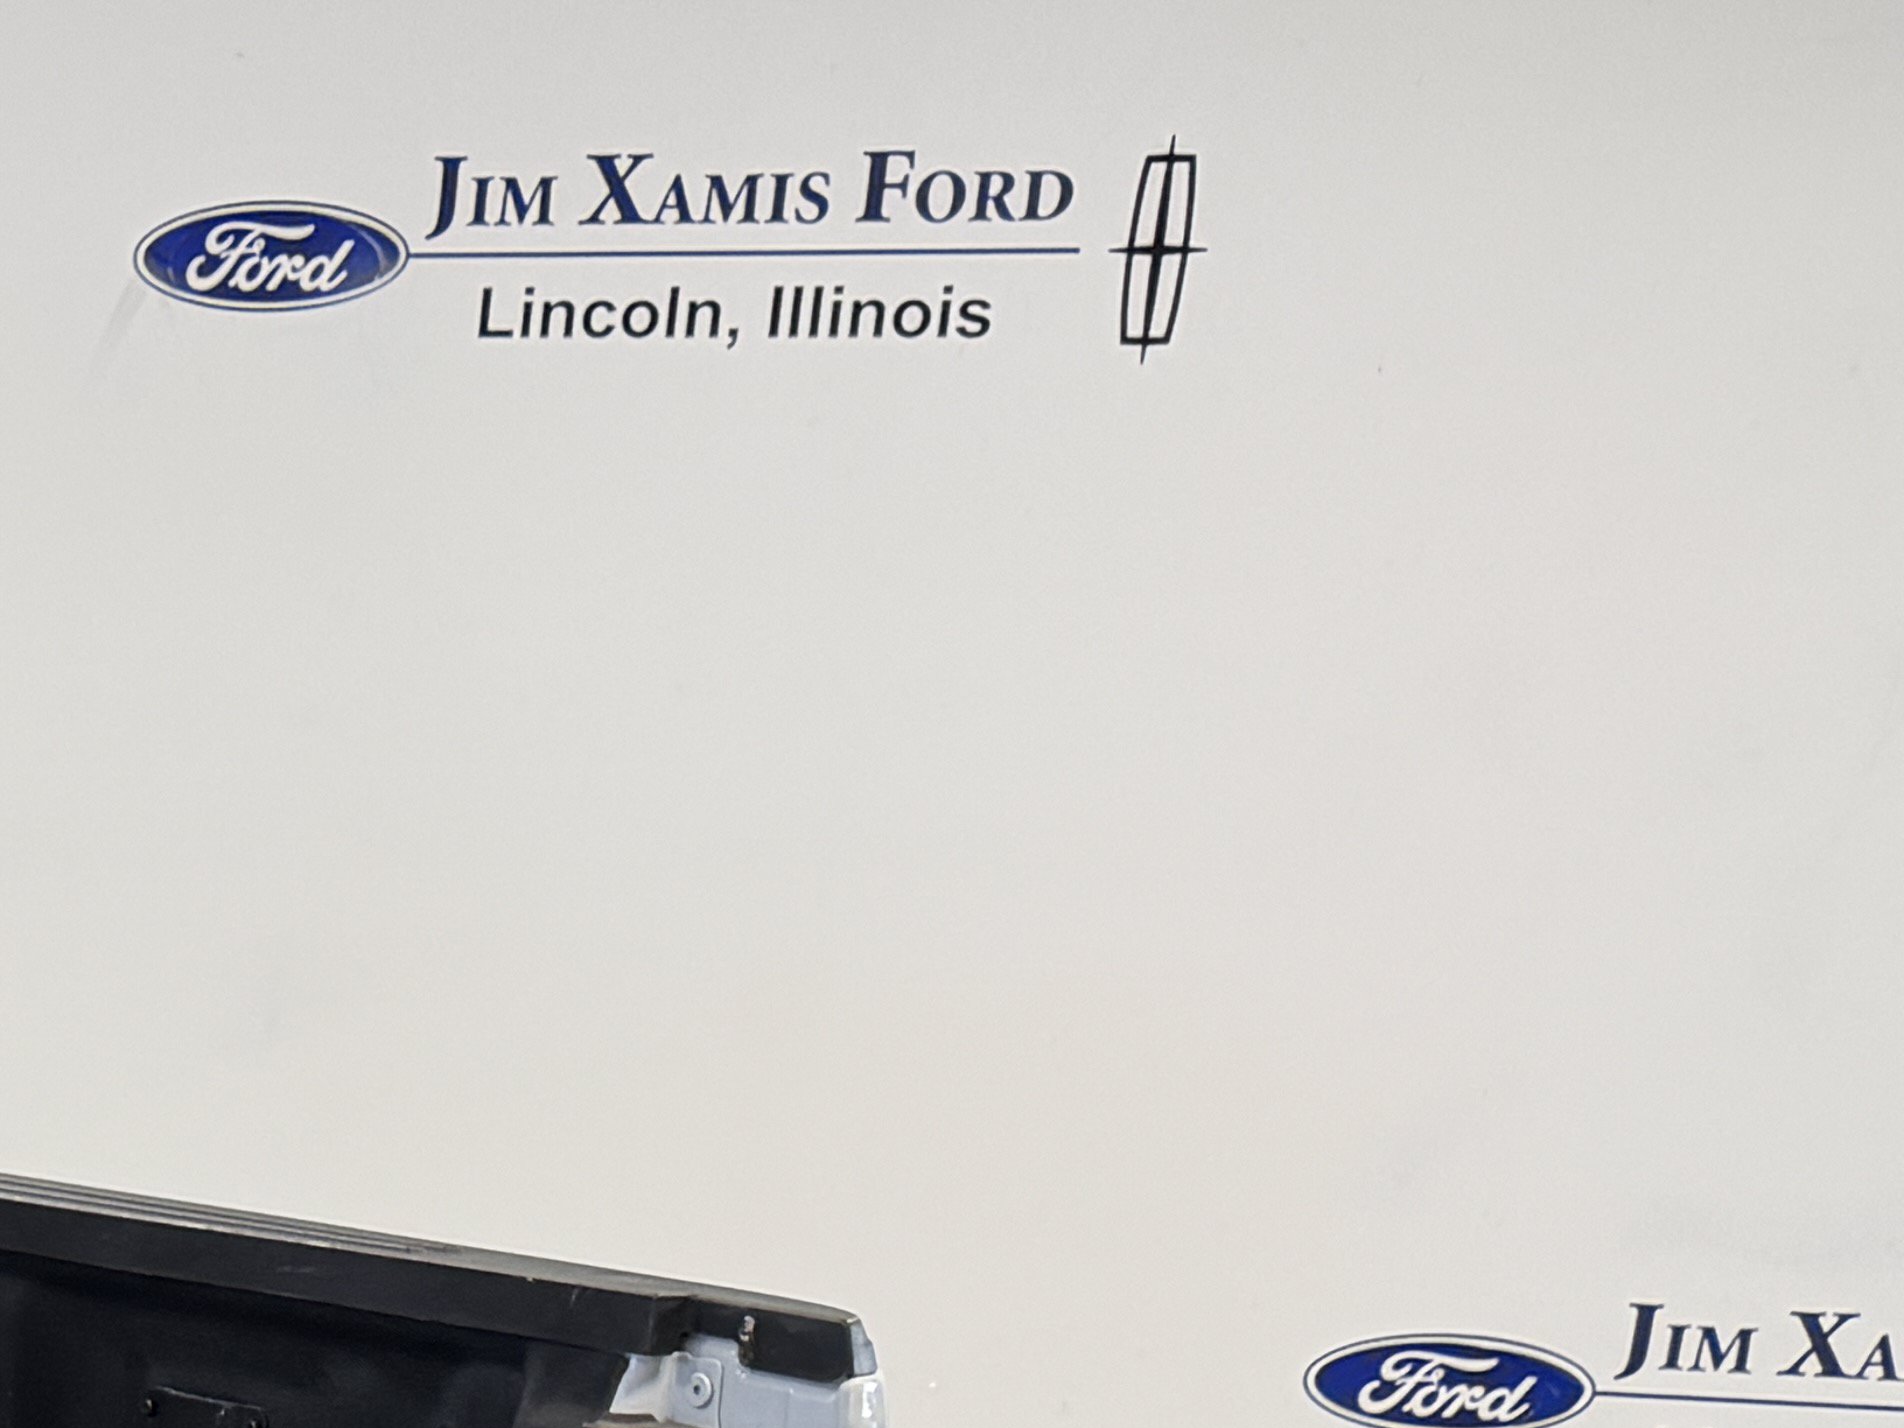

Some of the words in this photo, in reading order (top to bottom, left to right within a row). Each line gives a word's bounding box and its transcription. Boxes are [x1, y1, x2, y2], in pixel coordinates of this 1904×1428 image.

[424, 155, 559, 241] JIM
[577, 153, 830, 227] XAMIS
[855, 150, 1074, 224] FORD
[186, 221, 355, 292] Ford
[478, 285, 739, 350] Lincoln,
[768, 285, 991, 339] Illinois
[1613, 1302, 1759, 1381] JIM
[1357, 1350, 1537, 1422] Ford
